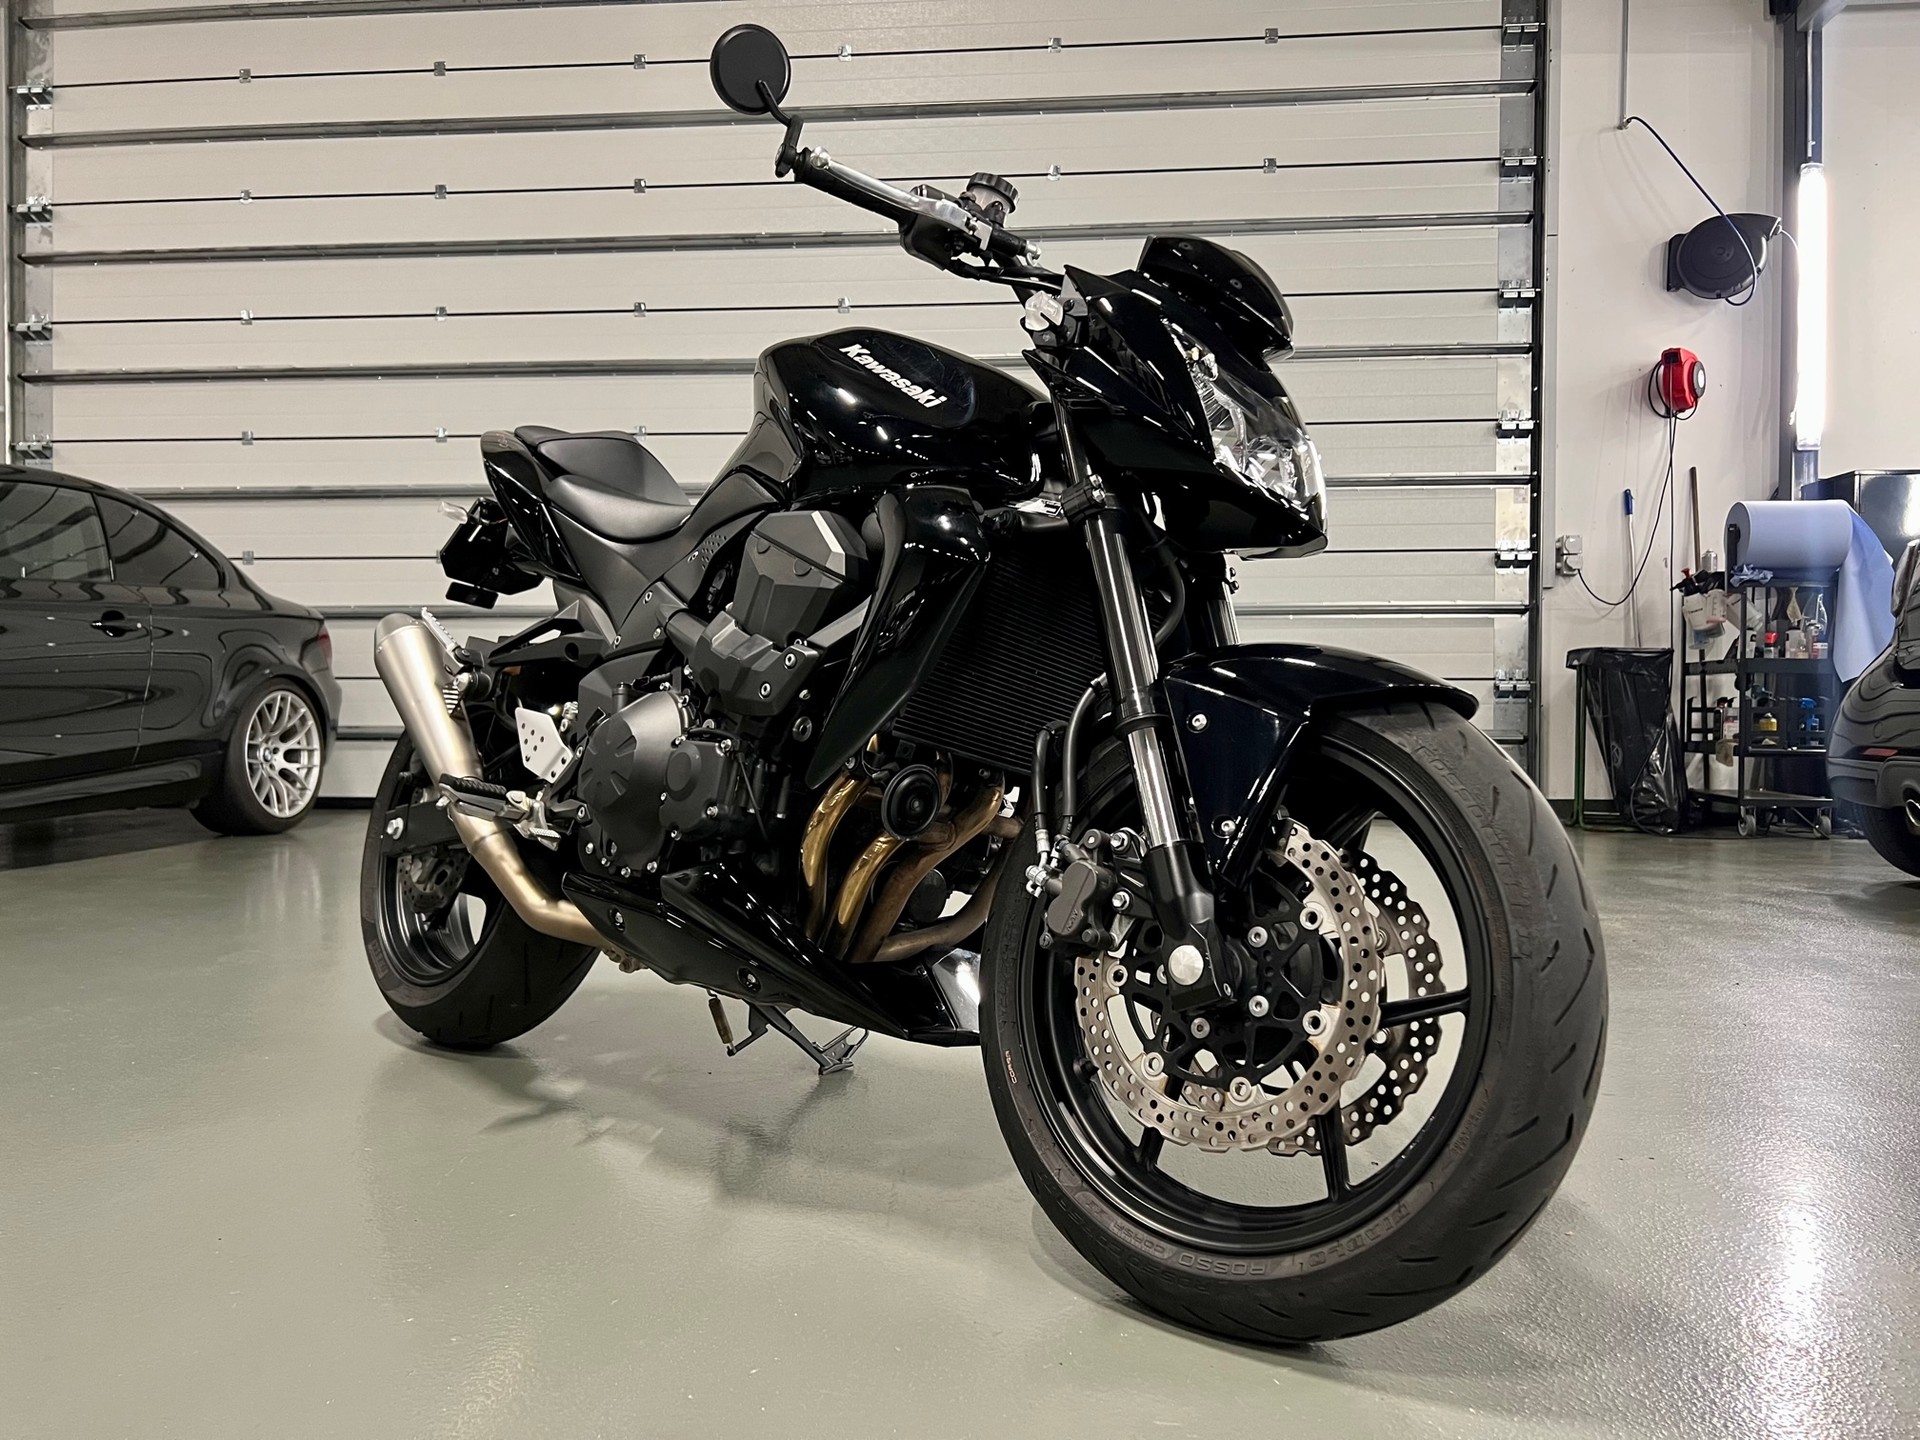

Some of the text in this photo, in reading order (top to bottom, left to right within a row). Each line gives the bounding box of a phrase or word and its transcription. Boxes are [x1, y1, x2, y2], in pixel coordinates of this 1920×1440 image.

[839, 344, 948, 408] Kawasaki
[1111, 1220, 1166, 1255] CORSA
[1177, 1252, 1266, 1276] ROSSO
